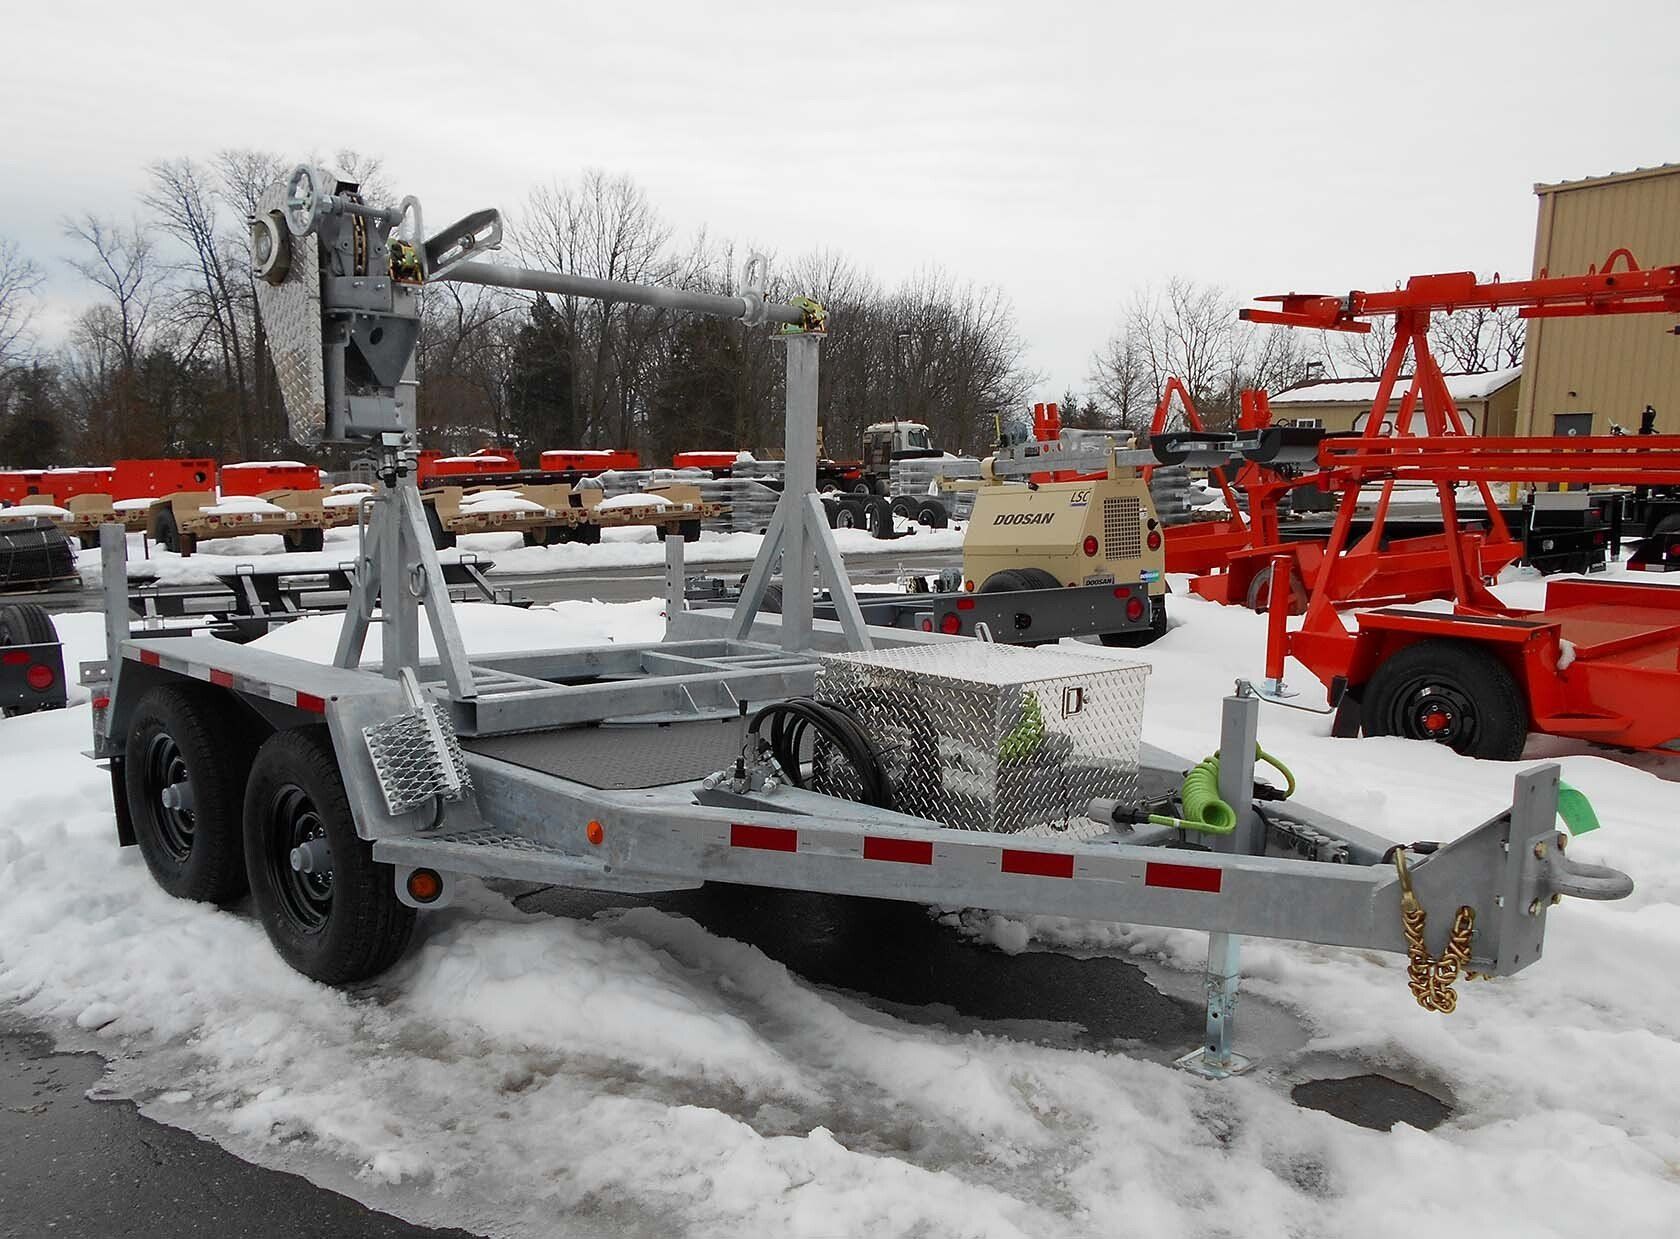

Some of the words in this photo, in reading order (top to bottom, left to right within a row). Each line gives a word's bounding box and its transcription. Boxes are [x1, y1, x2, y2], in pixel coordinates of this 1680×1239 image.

[1070, 491, 1090, 503] LSC
[993, 513, 1055, 526] DOOSAN
[1086, 578, 1112, 586] DOOSAN
